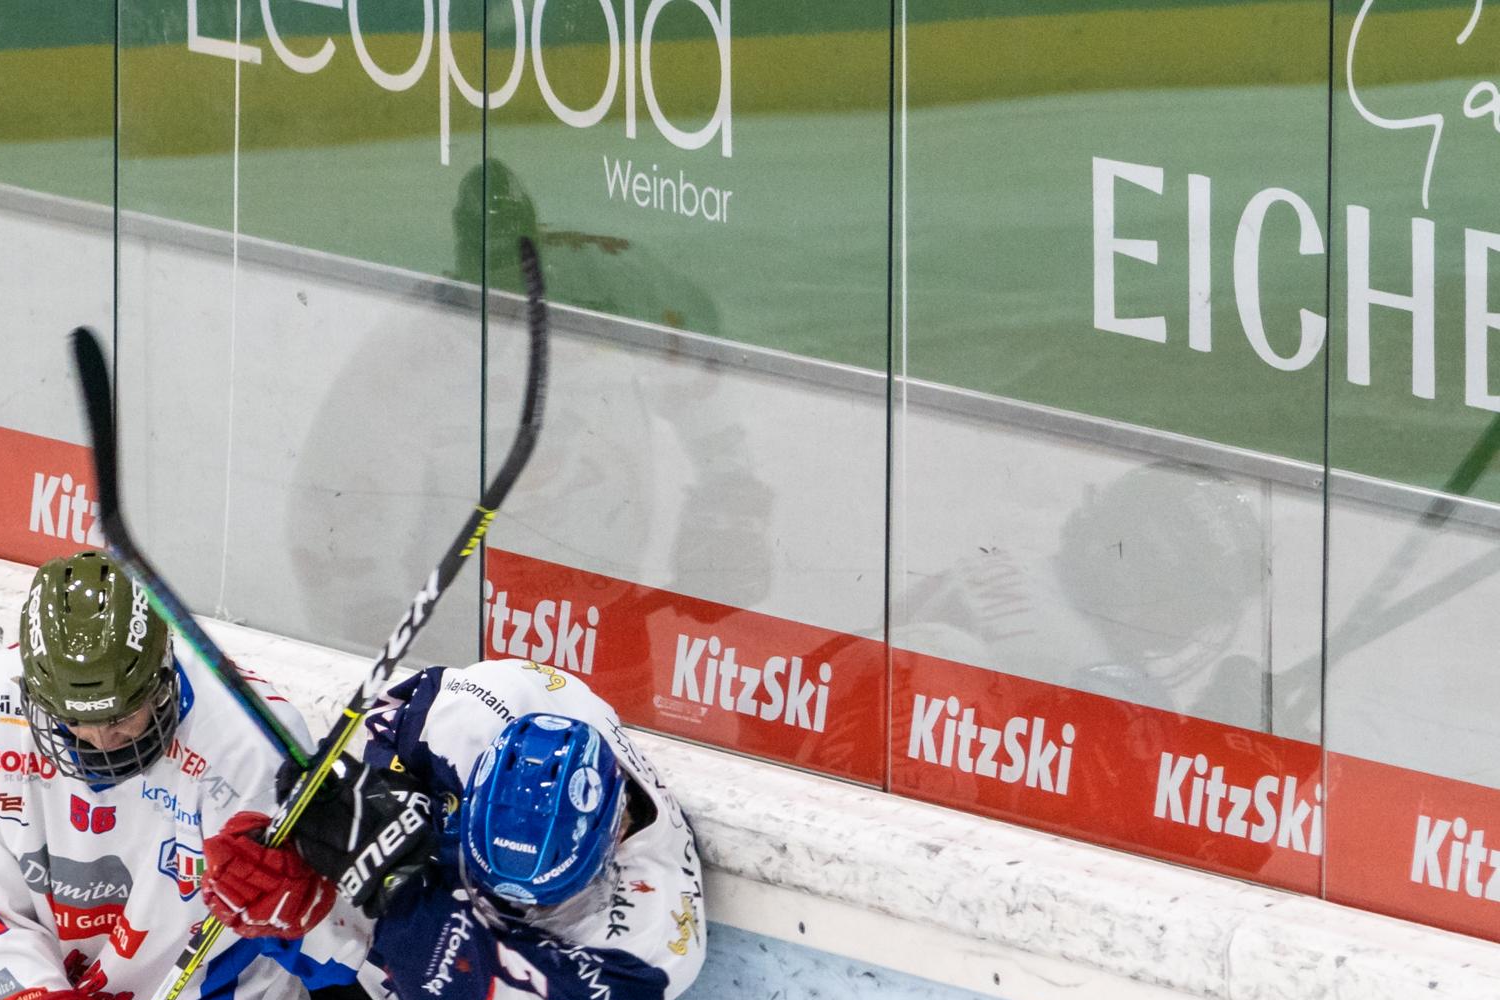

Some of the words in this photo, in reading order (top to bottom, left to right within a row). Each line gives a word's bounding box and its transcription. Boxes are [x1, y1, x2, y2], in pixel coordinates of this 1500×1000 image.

[187, 0, 732, 164] eopold
[603, 155, 732, 223] Weinbar
[29, 472, 105, 548] Kitz
[485, 580, 599, 675] itzSki
[65, 696, 116, 712] FORST
[672, 633, 832, 733] KitzSki
[909, 694, 1077, 796] KitzSki
[1153, 752, 1328, 856] KitzSki
[23, 859, 129, 902] Domites
[1411, 815, 1500, 902] Kitz
